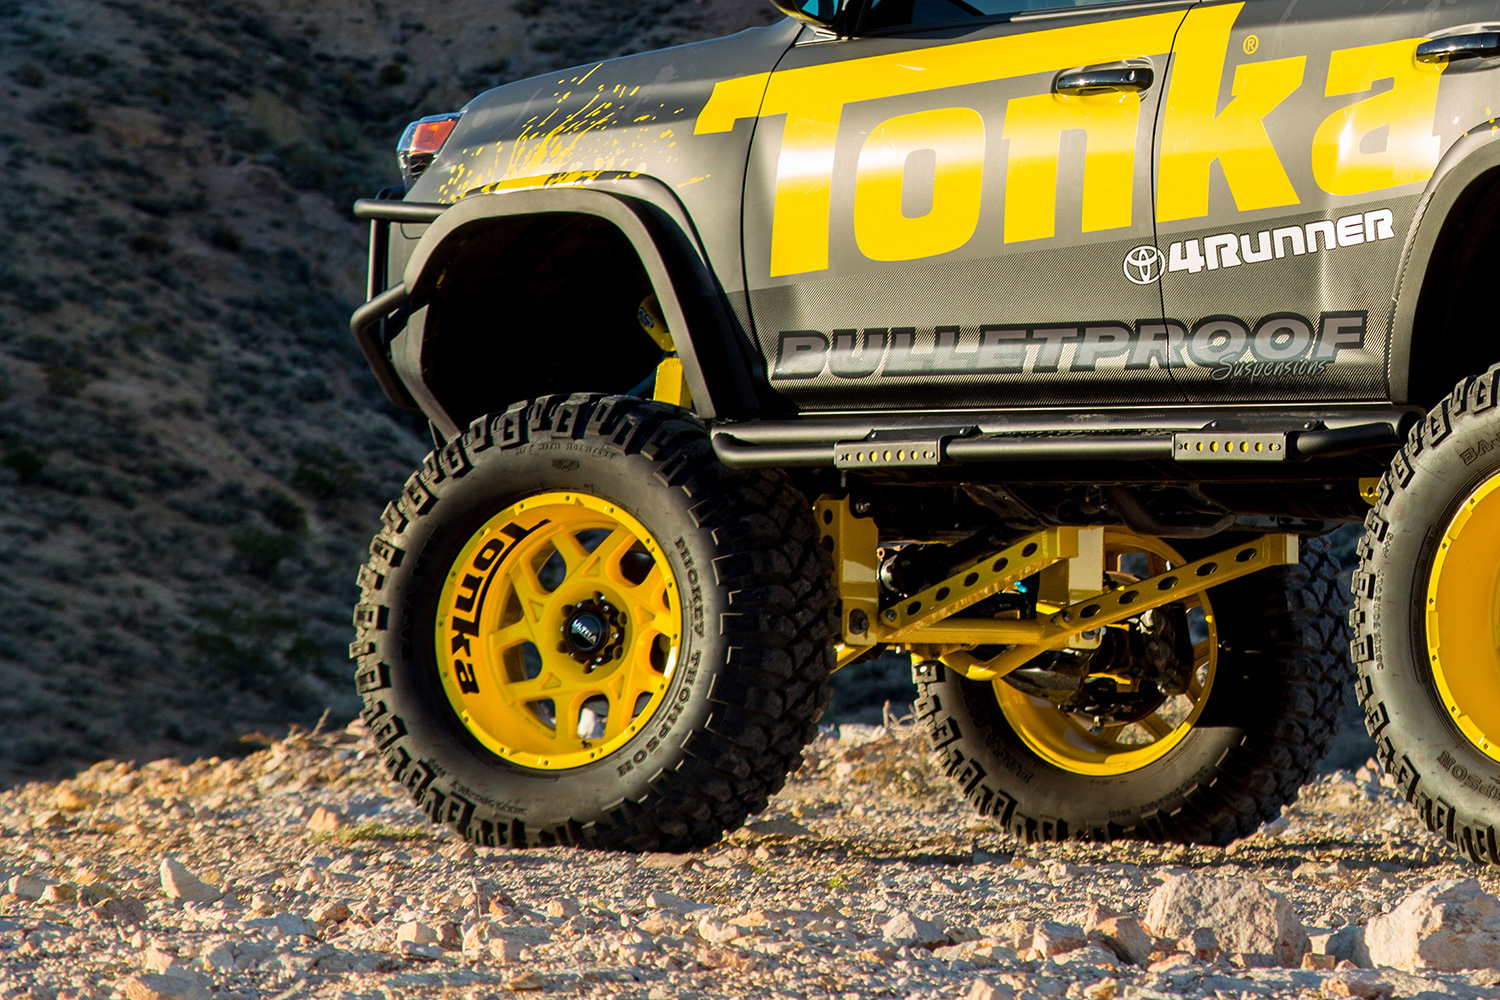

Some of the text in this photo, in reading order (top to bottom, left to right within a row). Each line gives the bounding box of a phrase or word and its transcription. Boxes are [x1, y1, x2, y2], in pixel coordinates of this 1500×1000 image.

[693, 1, 1447, 278] Tonka
[774, 309, 1369, 381] BULLETPROOF
[1211, 350, 1327, 384] Suspensions
[451, 518, 552, 694] Tonka
[616, 649, 702, 778] THOMPSON
